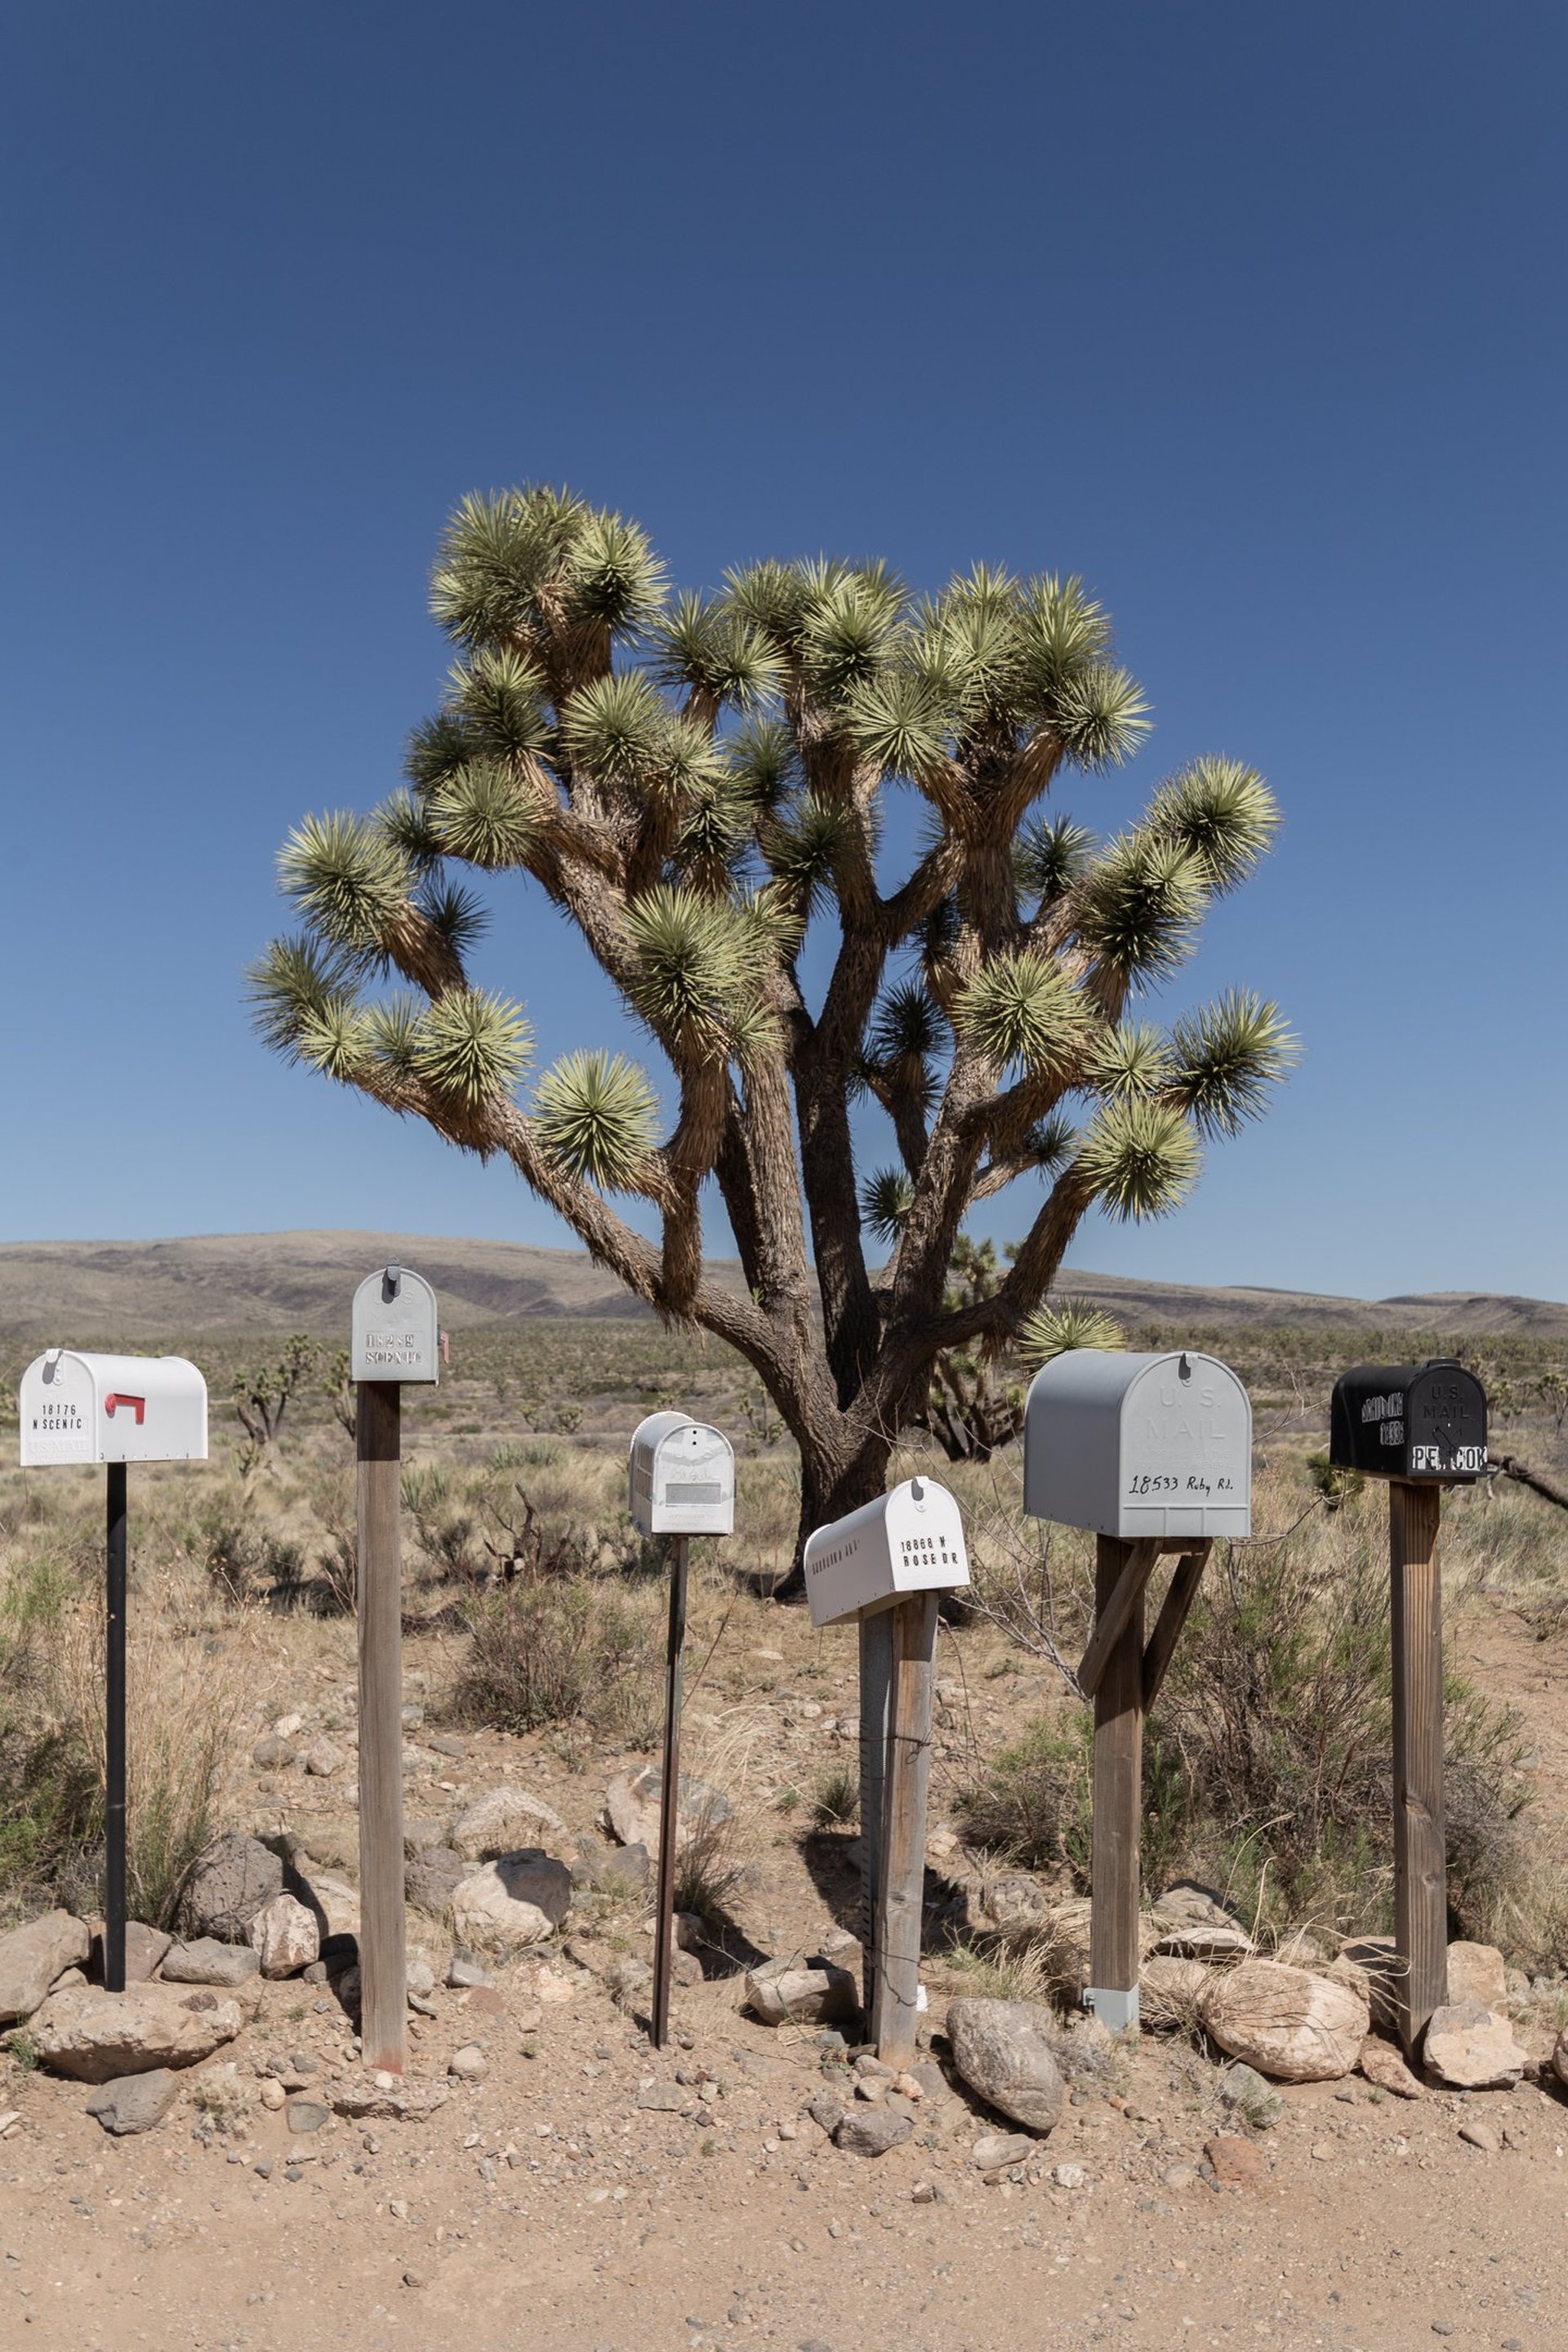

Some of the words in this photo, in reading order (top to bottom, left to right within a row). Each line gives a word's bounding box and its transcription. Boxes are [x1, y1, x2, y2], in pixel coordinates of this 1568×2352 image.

[366, 1351, 422, 1365] SCENIC
[1431, 1385, 1464, 1400] U.S.
[42, 1403, 76, 1415] 18176
[1424, 1405, 1471, 1419] MAIL
[32, 1419, 38, 1430] N
[42, 1418, 82, 1430] SCENIC
[1147, 1417, 1227, 1440] MAIL
[1129, 1475, 1178, 1494] 18533
[1187, 1476, 1211, 1497] Ruby
[903, 1553, 936, 1566] ROSE
[942, 1552, 958, 1564] DR
